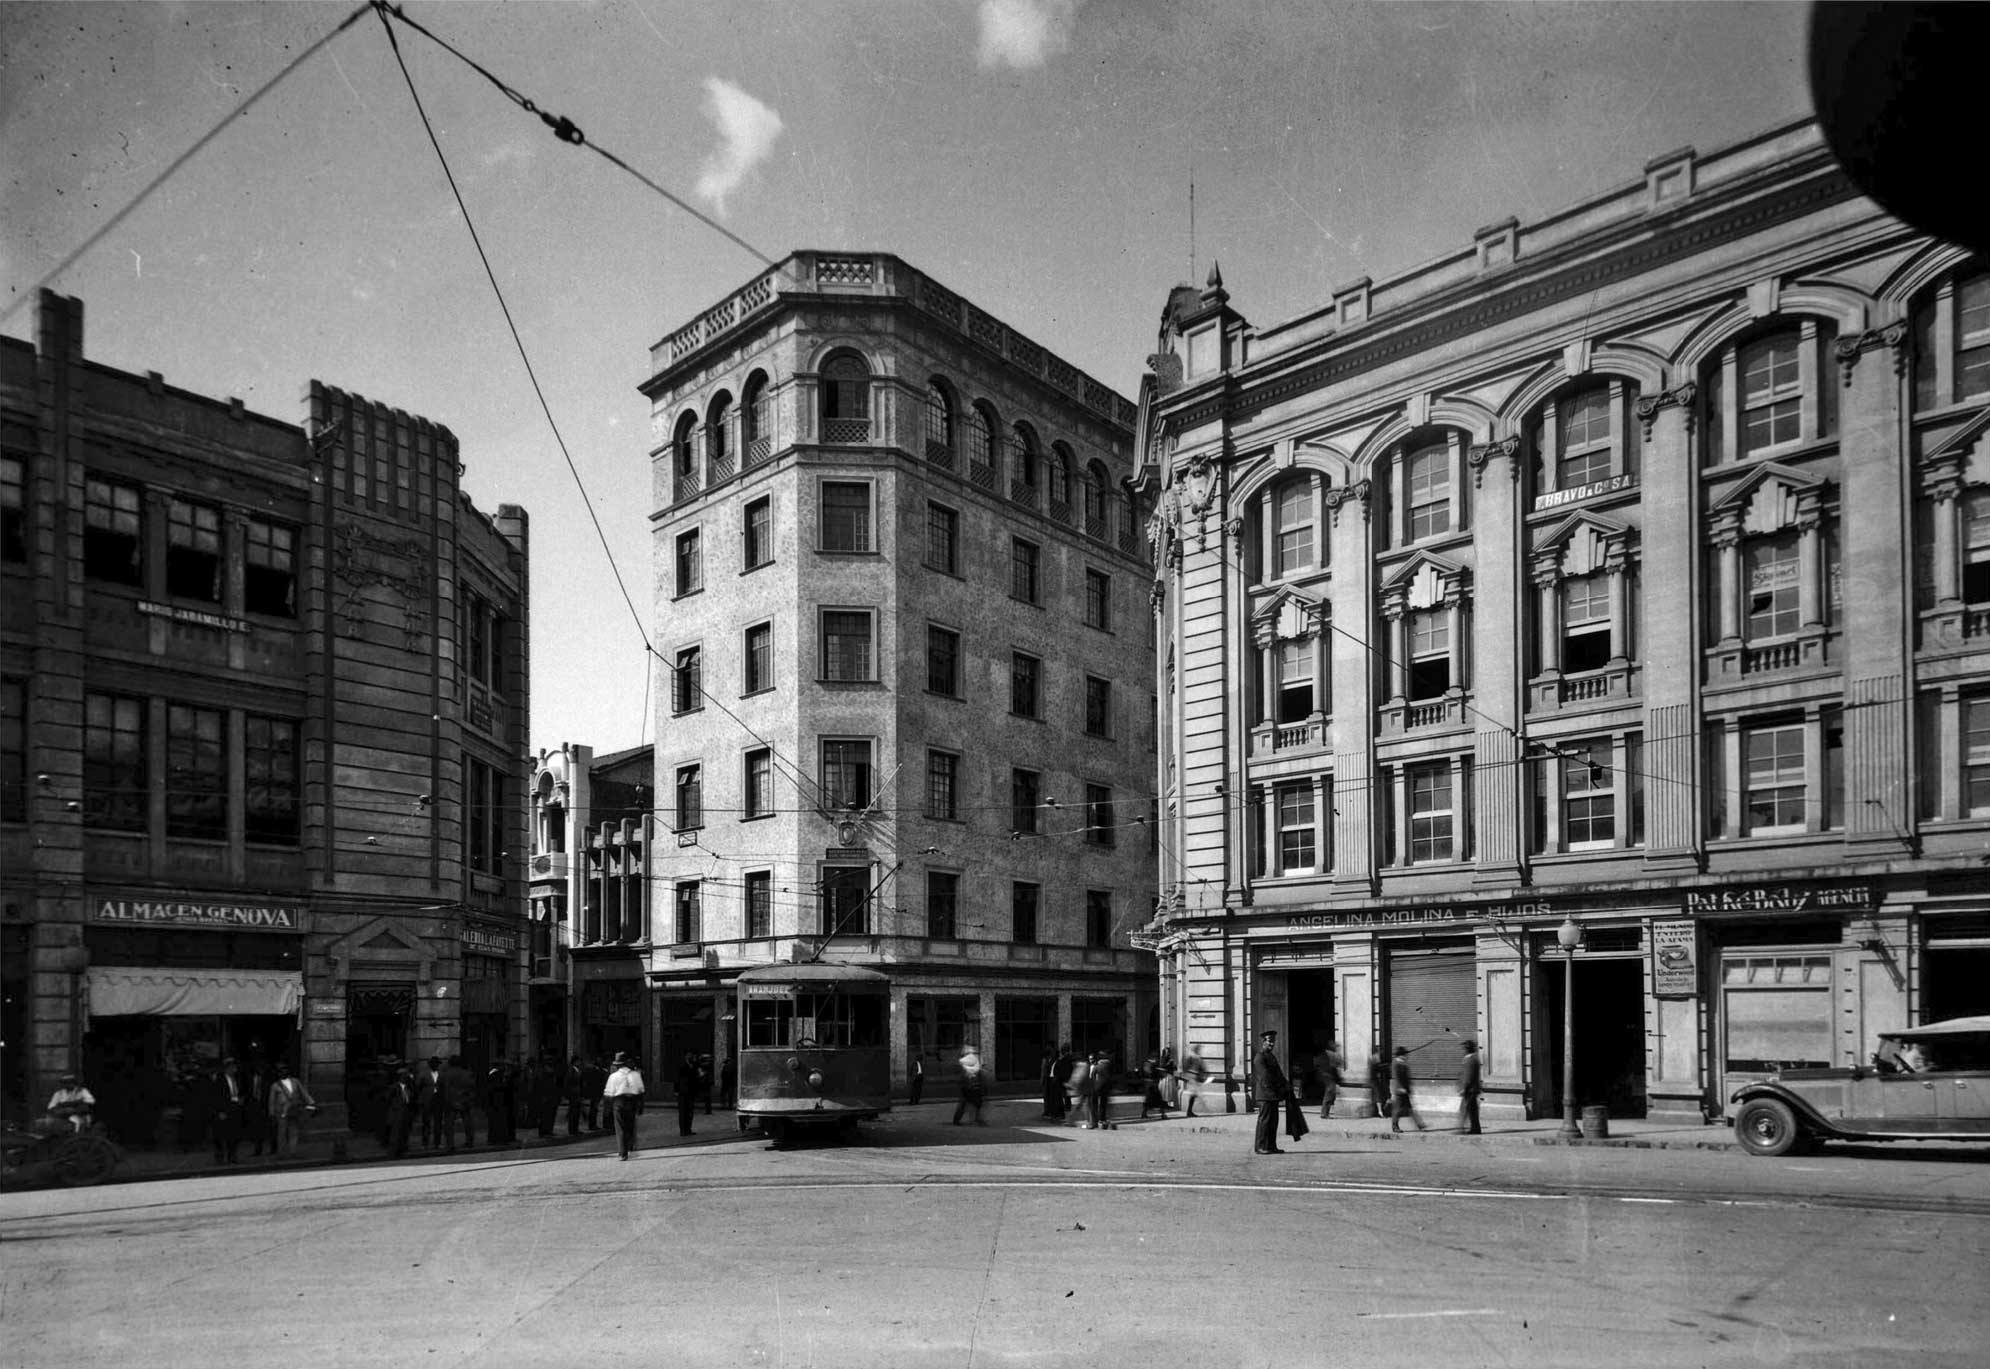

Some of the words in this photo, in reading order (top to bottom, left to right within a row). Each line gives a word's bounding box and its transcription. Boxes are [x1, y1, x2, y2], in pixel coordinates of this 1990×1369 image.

[1546, 485, 1586, 506] BRAVO
[175, 609, 237, 627] JARAMILLO
[99, 901, 201, 919] ALMACEN
[206, 906, 291, 926] GENOVA
[1287, 912, 1374, 931] ANGELINA
[1380, 908, 1455, 926] MOLINA
[1486, 902, 1552, 919] HIJOS
